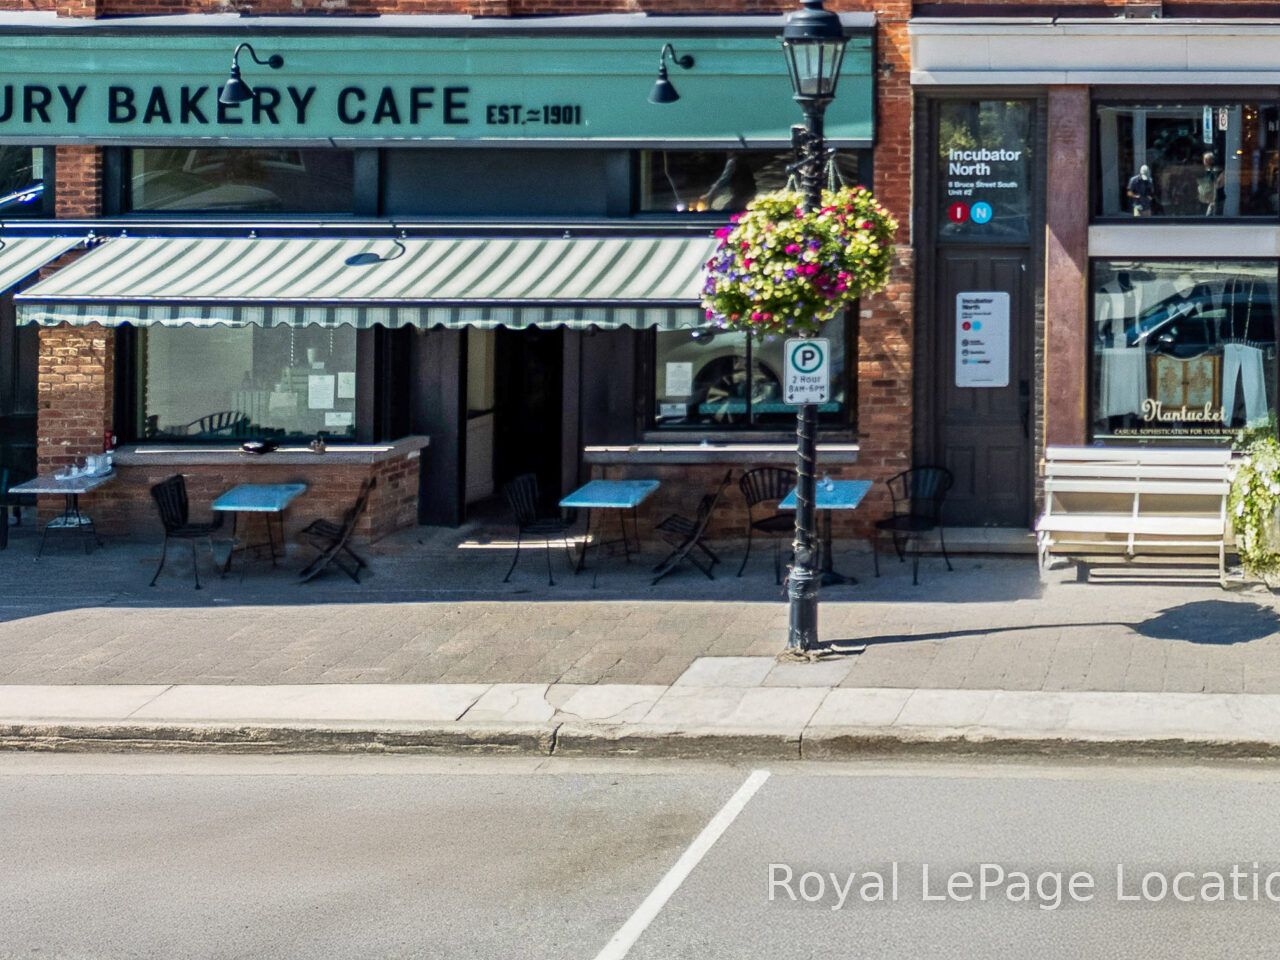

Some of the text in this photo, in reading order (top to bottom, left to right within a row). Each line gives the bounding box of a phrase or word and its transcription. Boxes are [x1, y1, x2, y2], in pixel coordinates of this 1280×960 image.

[108, 86, 316, 125] BAKERY
[337, 86, 470, 125] CAFE
[949, 148, 1021, 161] Incubator
[949, 162, 991, 176] North
[802, 350, 815, 367] P
[1141, 398, 1228, 422] Nantucket
[1114, 428, 1138, 436] CASUAL
[1140, 428, 1189, 436] SOPHISTICATION
[1190, 428, 1202, 436] FOR
[1203, 428, 1220, 436] YOUR
